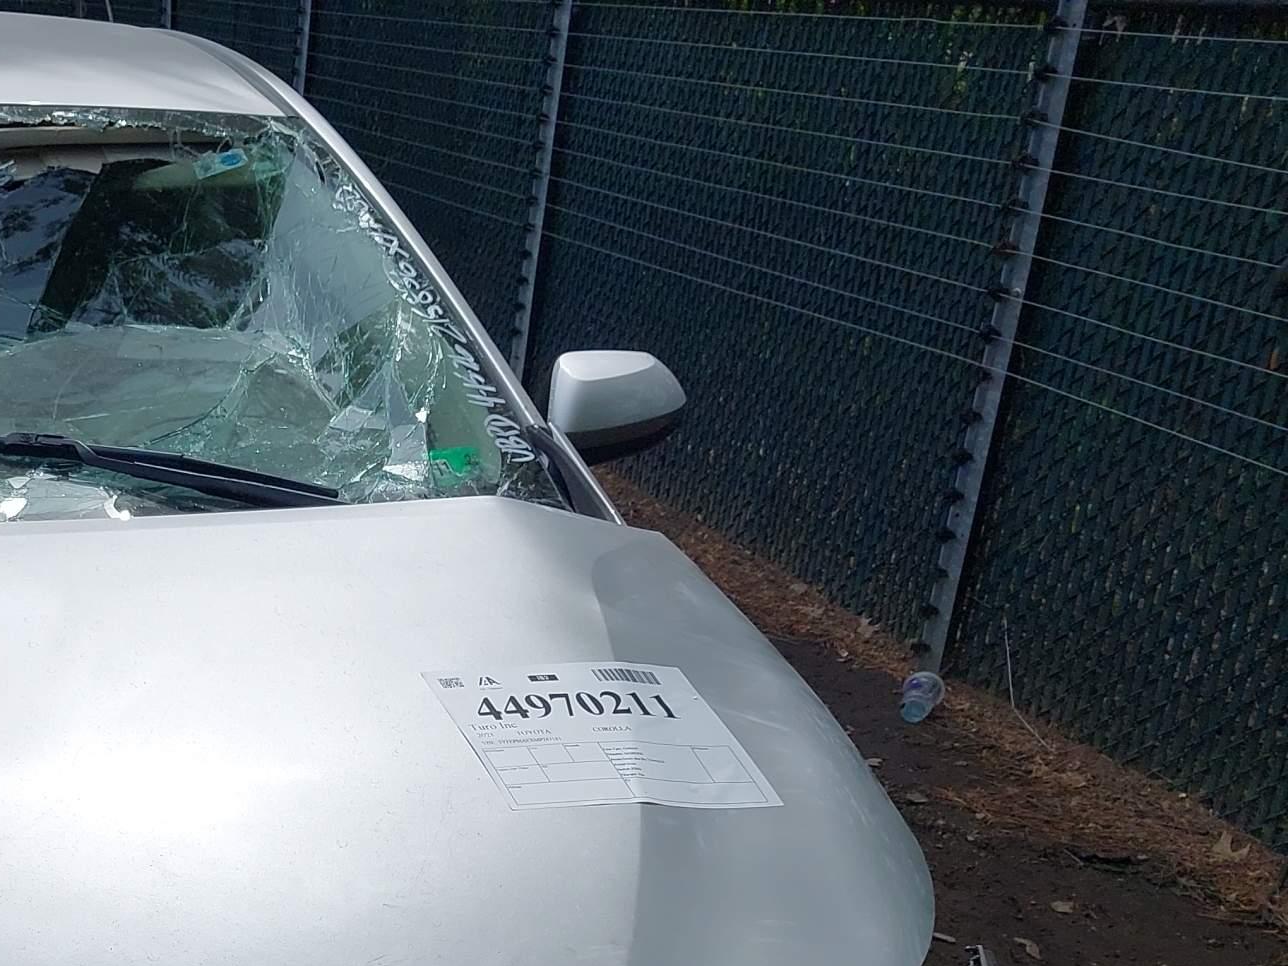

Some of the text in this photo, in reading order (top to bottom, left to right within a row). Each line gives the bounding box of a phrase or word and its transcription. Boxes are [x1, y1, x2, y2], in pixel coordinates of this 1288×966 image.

[478, 690, 680, 720] 44970211
[470, 721, 518, 731] Turo Inc
[517, 728, 552, 736] TOYOTA
[592, 725, 632, 733] COROLLA
